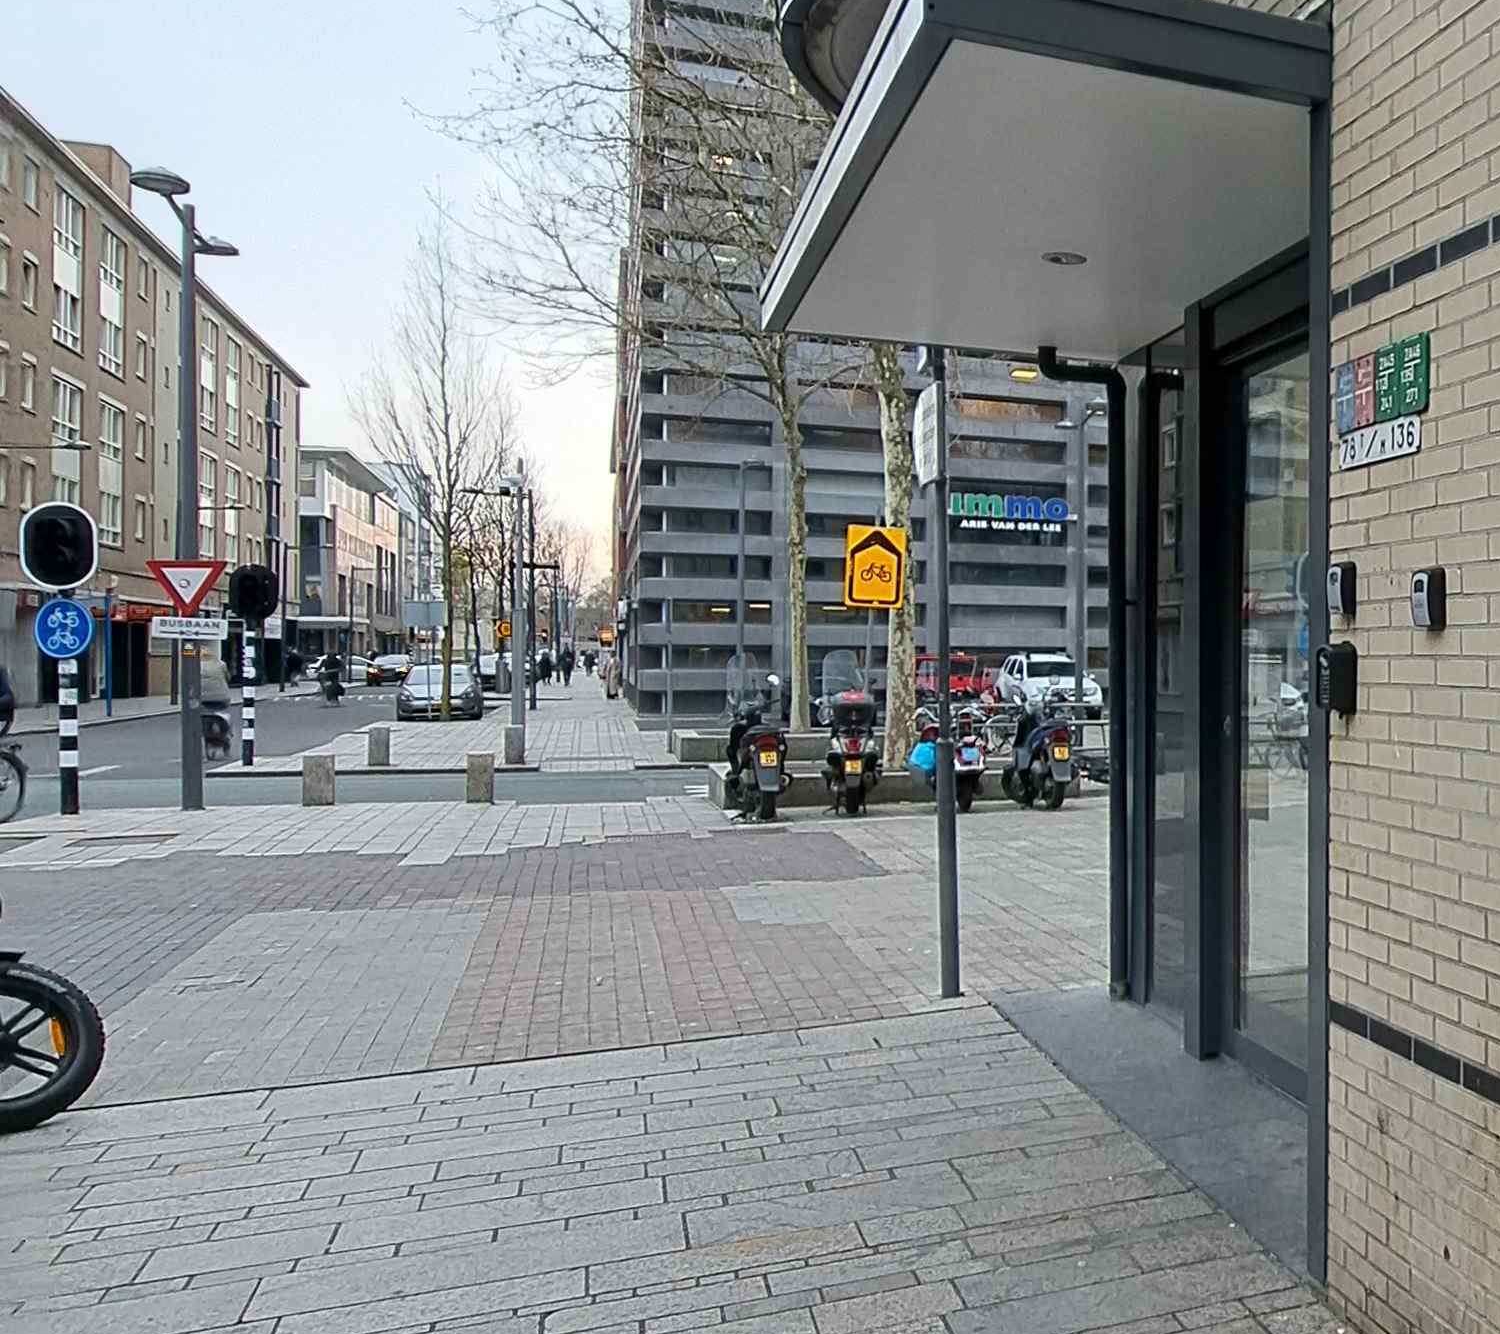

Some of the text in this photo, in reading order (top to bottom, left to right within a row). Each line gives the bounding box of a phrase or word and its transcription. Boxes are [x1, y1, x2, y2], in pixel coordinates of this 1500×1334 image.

[1391, 421, 1415, 451] 136
[950, 492, 1071, 522] immo
[991, 520, 1015, 530] VAN
[1018, 521, 1040, 531] DER
[160, 619, 220, 629] BUSBAAN
